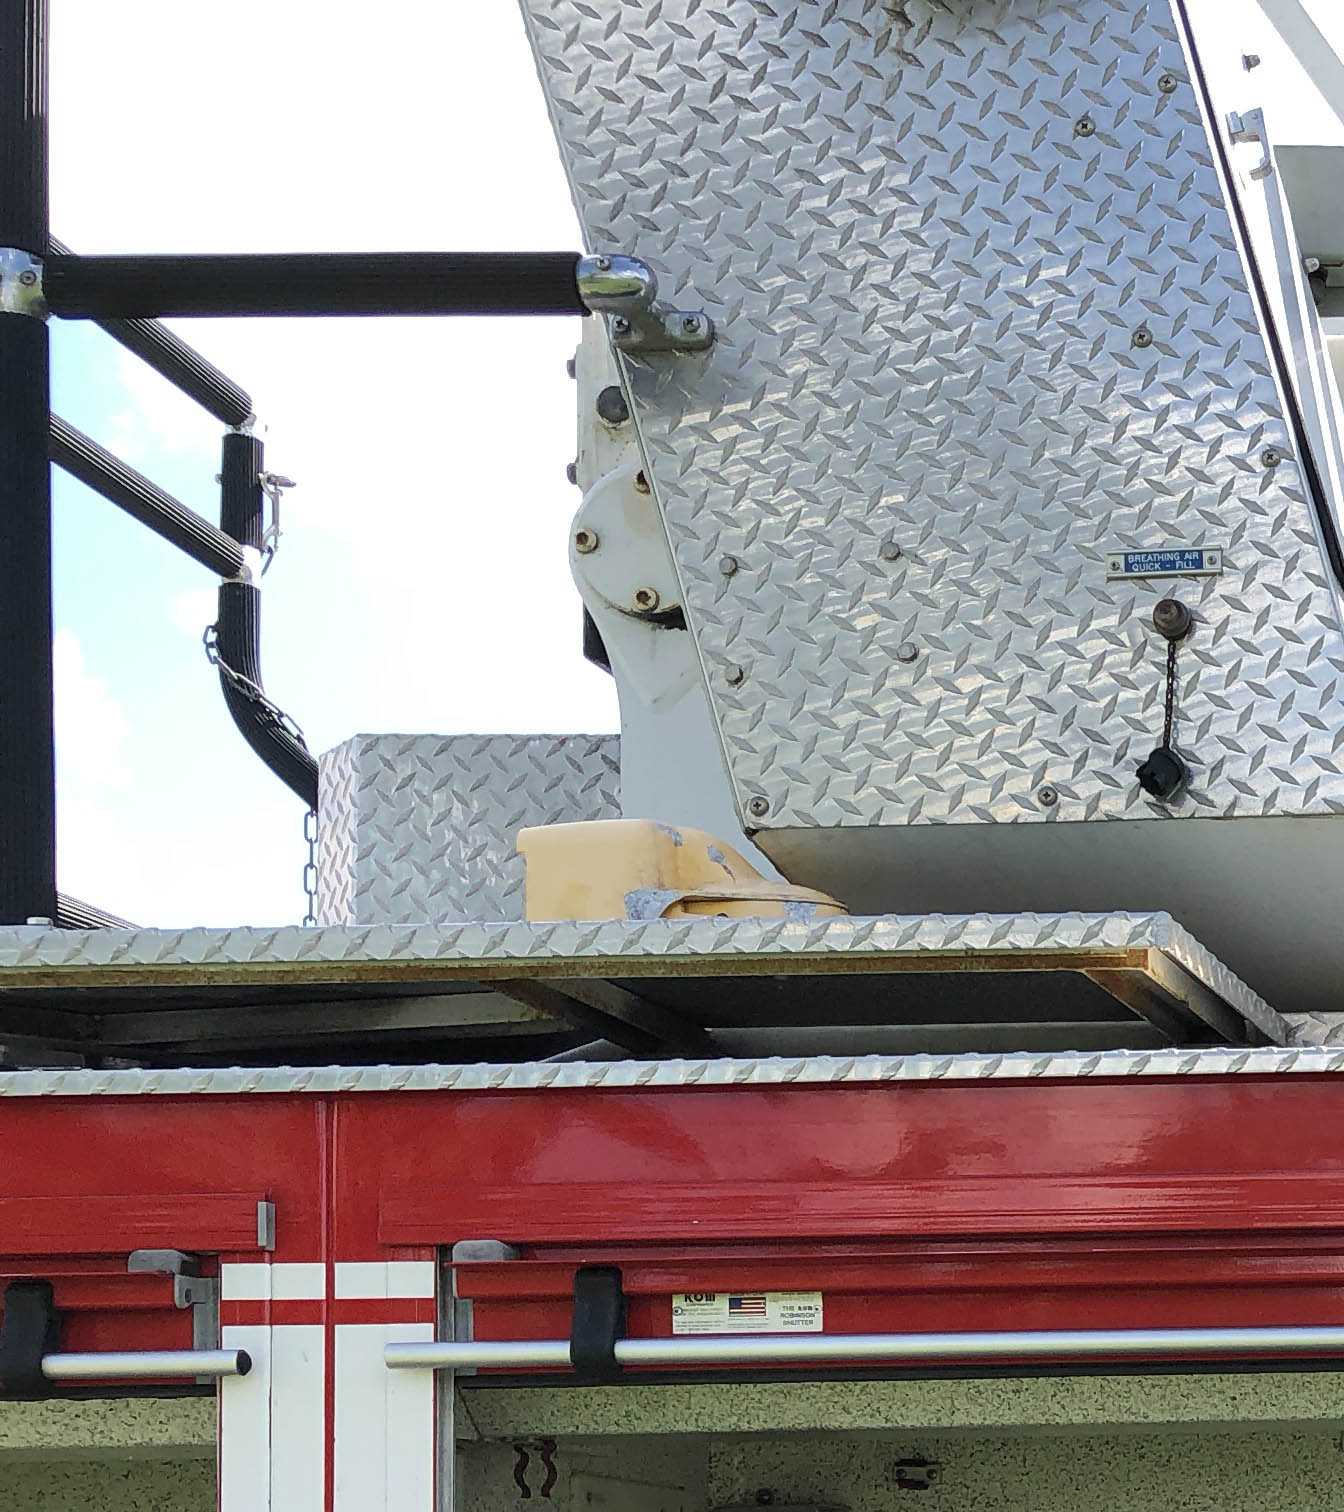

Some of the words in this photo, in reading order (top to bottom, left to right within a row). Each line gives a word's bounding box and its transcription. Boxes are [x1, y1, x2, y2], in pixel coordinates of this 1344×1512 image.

[1127, 552, 1181, 563] BREATHING
[1183, 551, 1199, 560] AIR
[1131, 562, 1161, 572] QUICK
[1175, 560, 1196, 570] FILL
